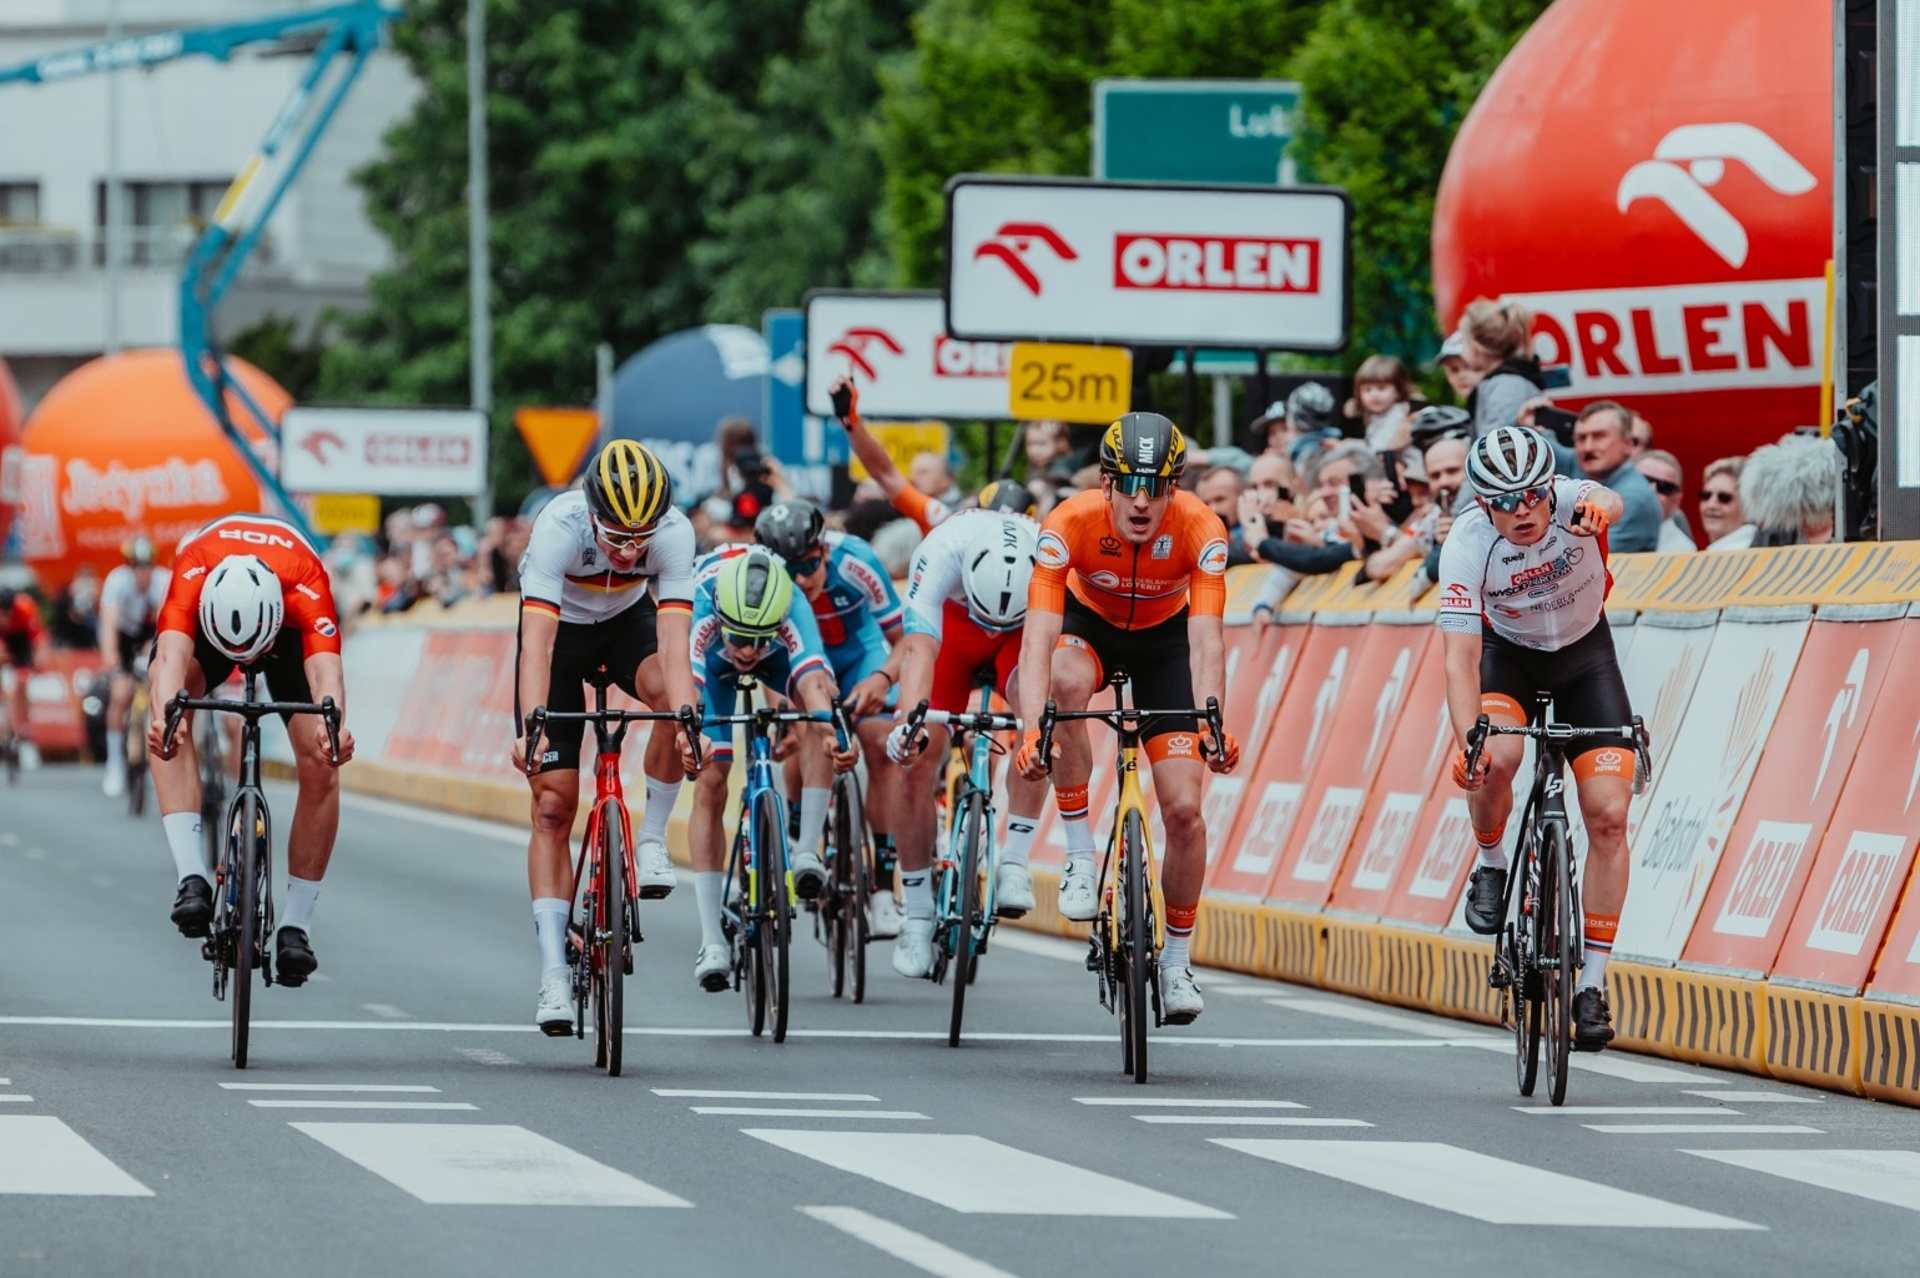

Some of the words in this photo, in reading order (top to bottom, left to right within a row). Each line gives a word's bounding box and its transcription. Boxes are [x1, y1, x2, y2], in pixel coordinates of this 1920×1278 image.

[1121, 237, 1311, 291] ORLEN
[1020, 360, 1118, 405] 25m
[1138, 436, 1155, 465] MICK
[218, 528, 295, 550] NOR
[845, 559, 885, 606] STRABAG
[1727, 838, 1803, 919] ORLEN
[1820, 848, 1898, 937] ORLEN
